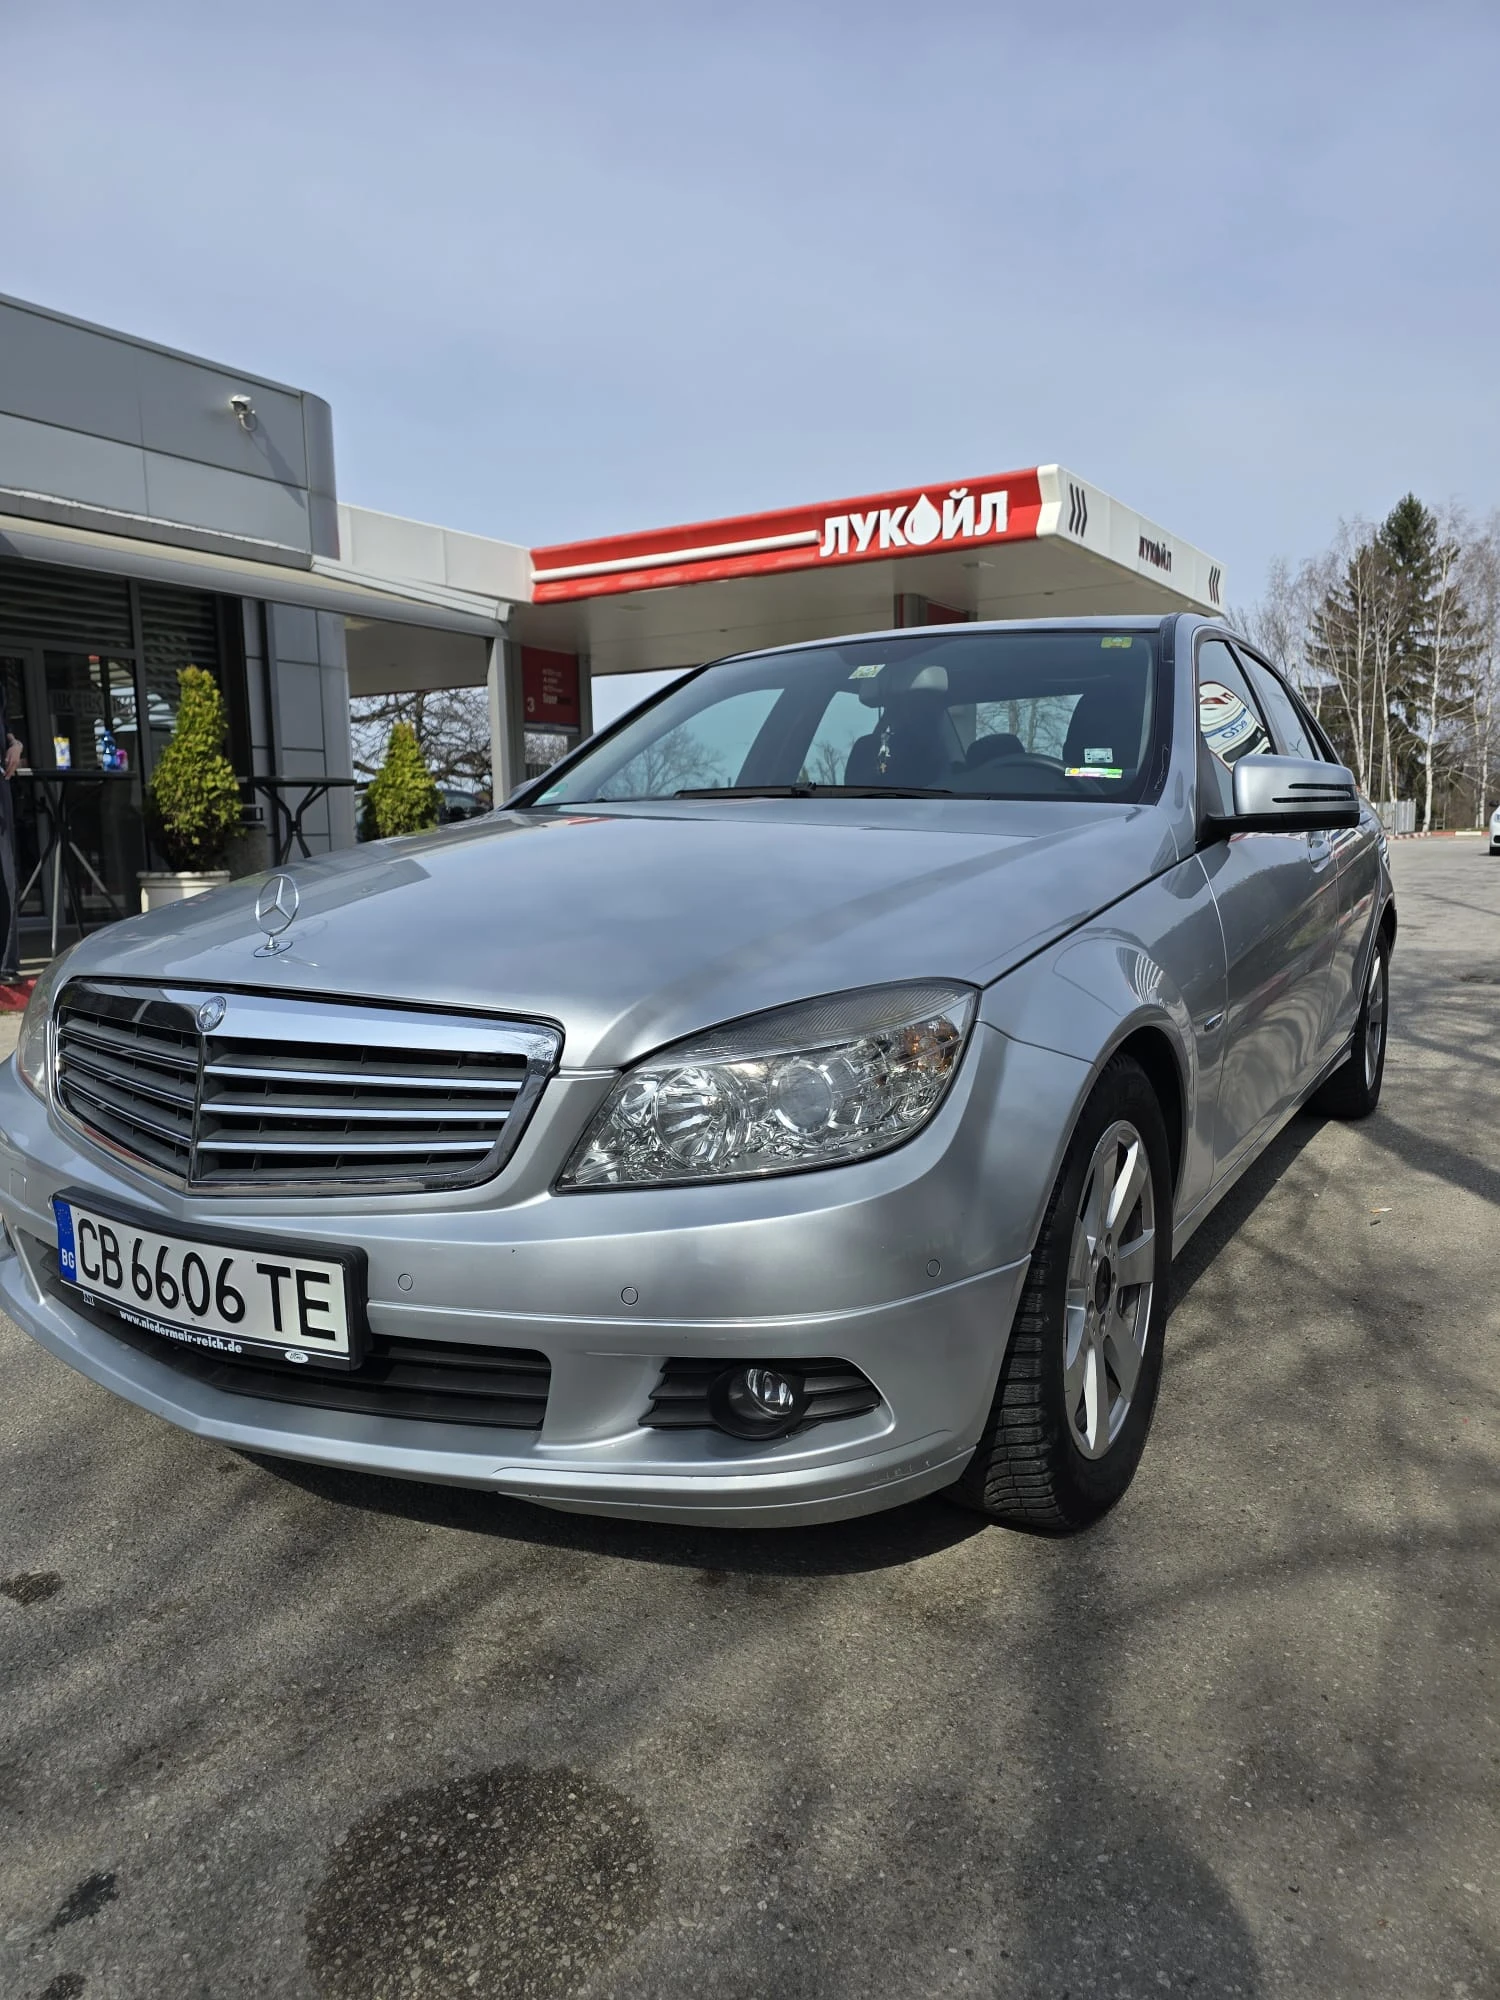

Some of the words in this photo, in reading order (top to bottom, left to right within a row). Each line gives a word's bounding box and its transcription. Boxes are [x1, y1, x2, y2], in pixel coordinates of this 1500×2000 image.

[819, 487, 1008, 557] ЛУКОЙЛ
[527, 697, 535, 713] 3
[61, 1248, 75, 1270] BG
[131, 1237, 246, 1324] 6606
[256, 1262, 336, 1341] TE
[119, 1309, 243, 1354] www.niedermair-reich.de
